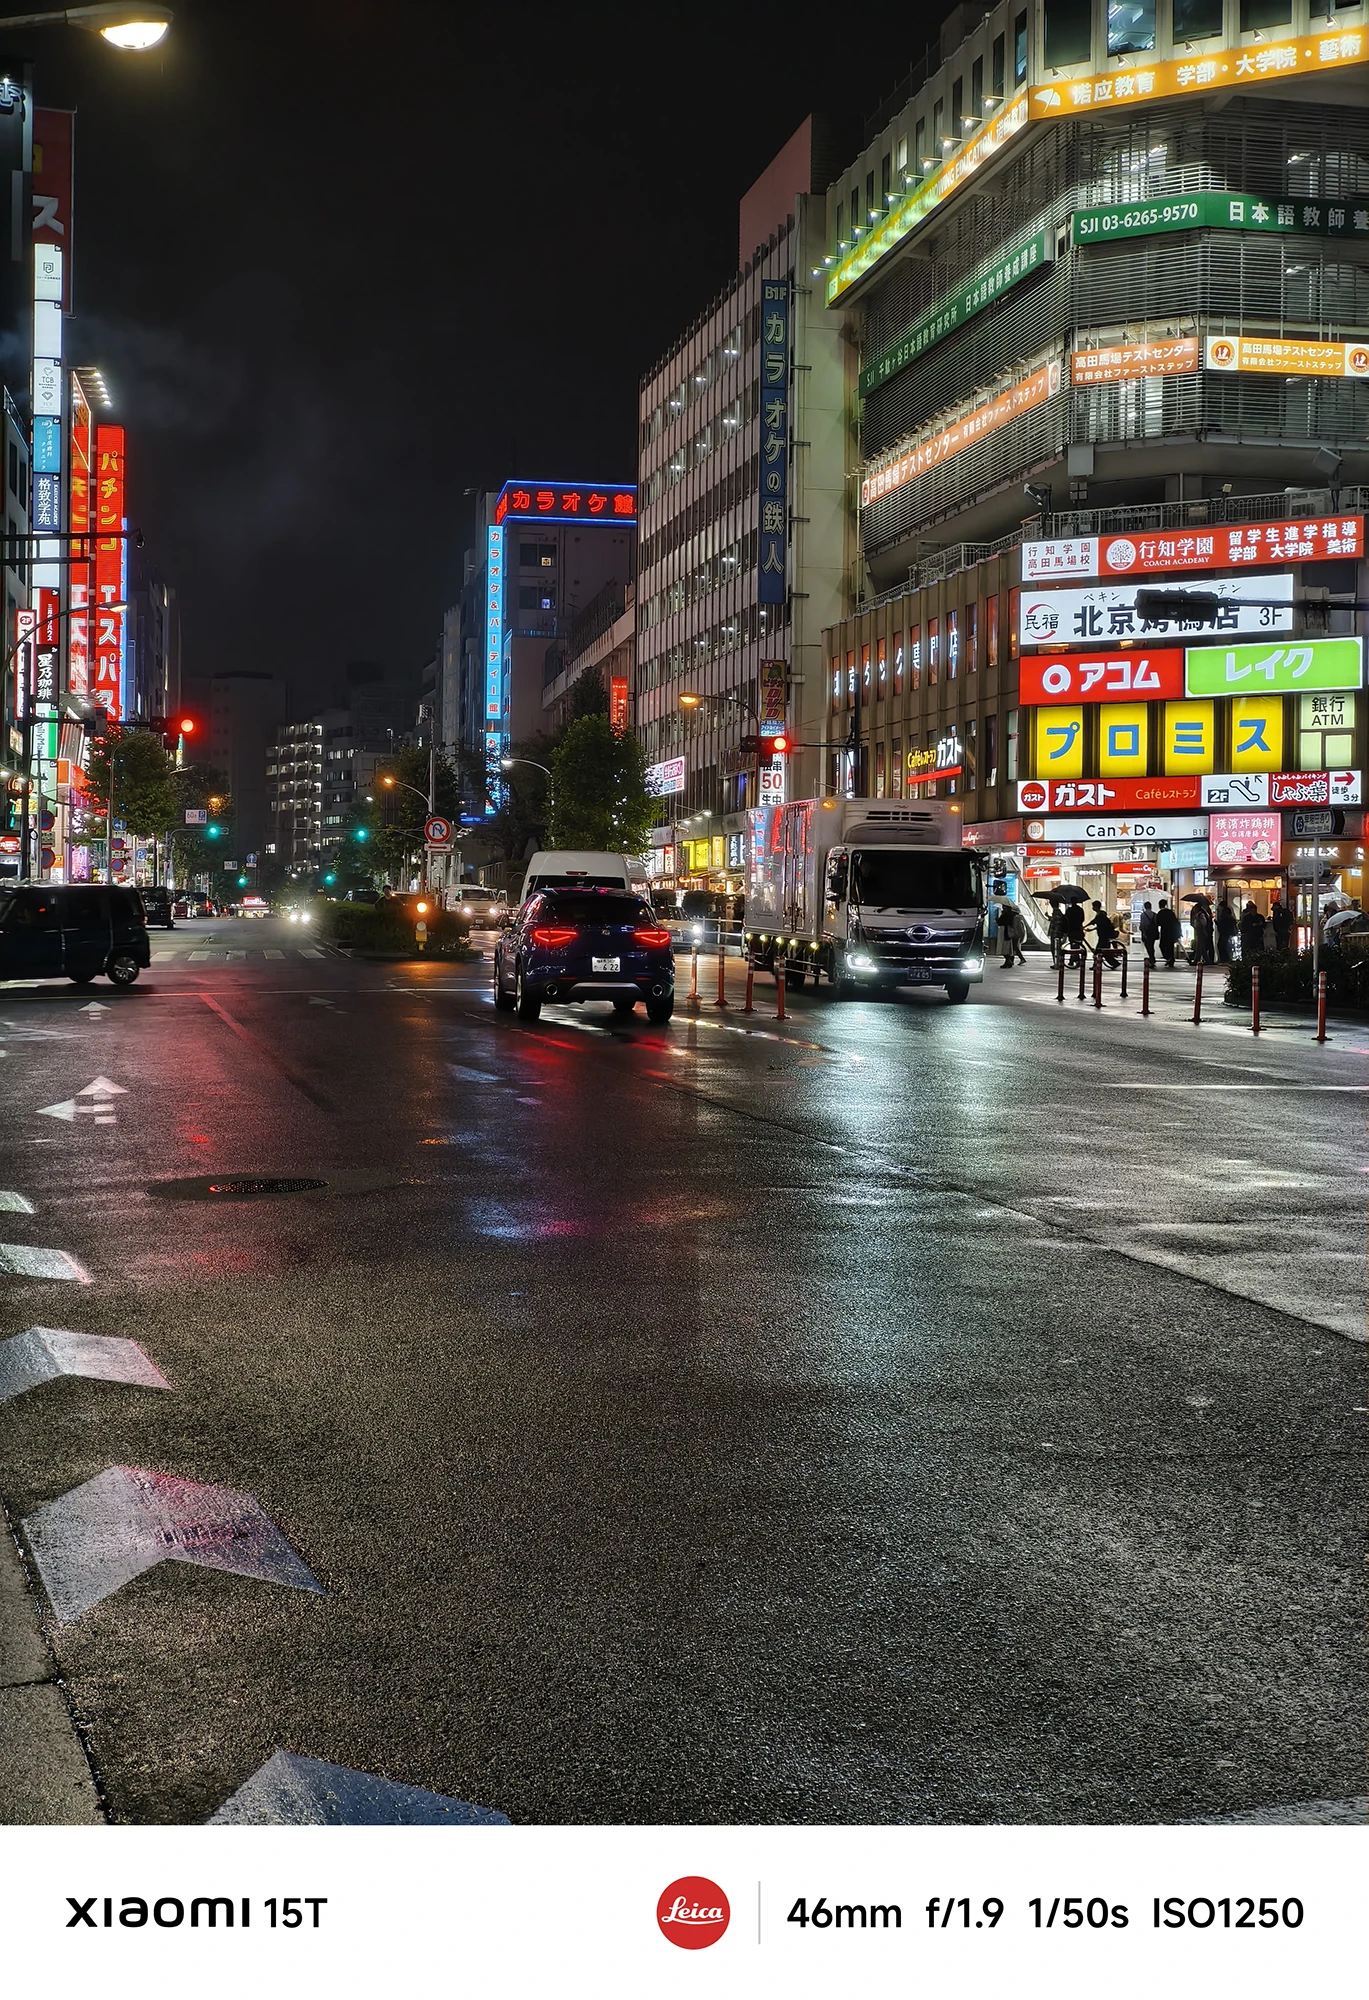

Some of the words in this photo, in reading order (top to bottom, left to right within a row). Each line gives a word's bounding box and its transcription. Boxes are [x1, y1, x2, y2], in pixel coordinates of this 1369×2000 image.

[1080, 217, 1099, 234] SJI
[1102, 202, 1198, 231] 03-6265-9570
[1228, 200, 1369, 231] 日本語教師養
[764, 285, 787, 300] B1F
[1075, 343, 1194, 368] 高田馬場テストセンター
[1242, 343, 1342, 358] 高田馬場テストセンター
[1075, 358, 1194, 381] 有限会社ファーストステップ
[1242, 357, 1342, 370] 有限会社ファーストステップ
[763, 311, 787, 575] カラオケの鉄人
[869, 434, 960, 499] 高田馬場テストセンター
[963, 376, 1044, 439] 有限会社ファーストステップ
[38, 478, 51, 525] 格致学苑
[101, 450, 118, 550] パチンコ
[512, 490, 634, 514] カラオケ館
[1229, 521, 1357, 545] 留学生進学指導
[1028, 541, 1091, 558] 行知学園
[1139, 536, 1215, 560] 行知学園
[1229, 549, 1257, 562] 学部
[1270, 542, 1314, 559] 大学院
[1328, 538, 1358, 555] 美術
[1028, 554, 1091, 570] 高田馬場校
[1173, 556, 1210, 566] ACADEMY
[1025, 612, 1060, 631] 民福
[1259, 607, 1283, 626] 3F
[1079, 660, 1161, 691] アコム
[1225, 648, 1314, 681] レイク
[37, 653, 53, 700] 星乃珈琲
[1312, 696, 1346, 713] 銀行
[1312, 714, 1345, 726] ATM
[1046, 719, 1271, 760] プロミス
[937, 736, 963, 767] ガスト
[762, 773, 782, 789] 50
[1273, 782, 1327, 803] しゃぶ葉
[1023, 793, 1044, 802] ガスト
[1055, 783, 1115, 806] ガスト
[1208, 791, 1229, 803] 2F
[1086, 825, 1116, 837] Can
[1134, 825, 1156, 836] Do
